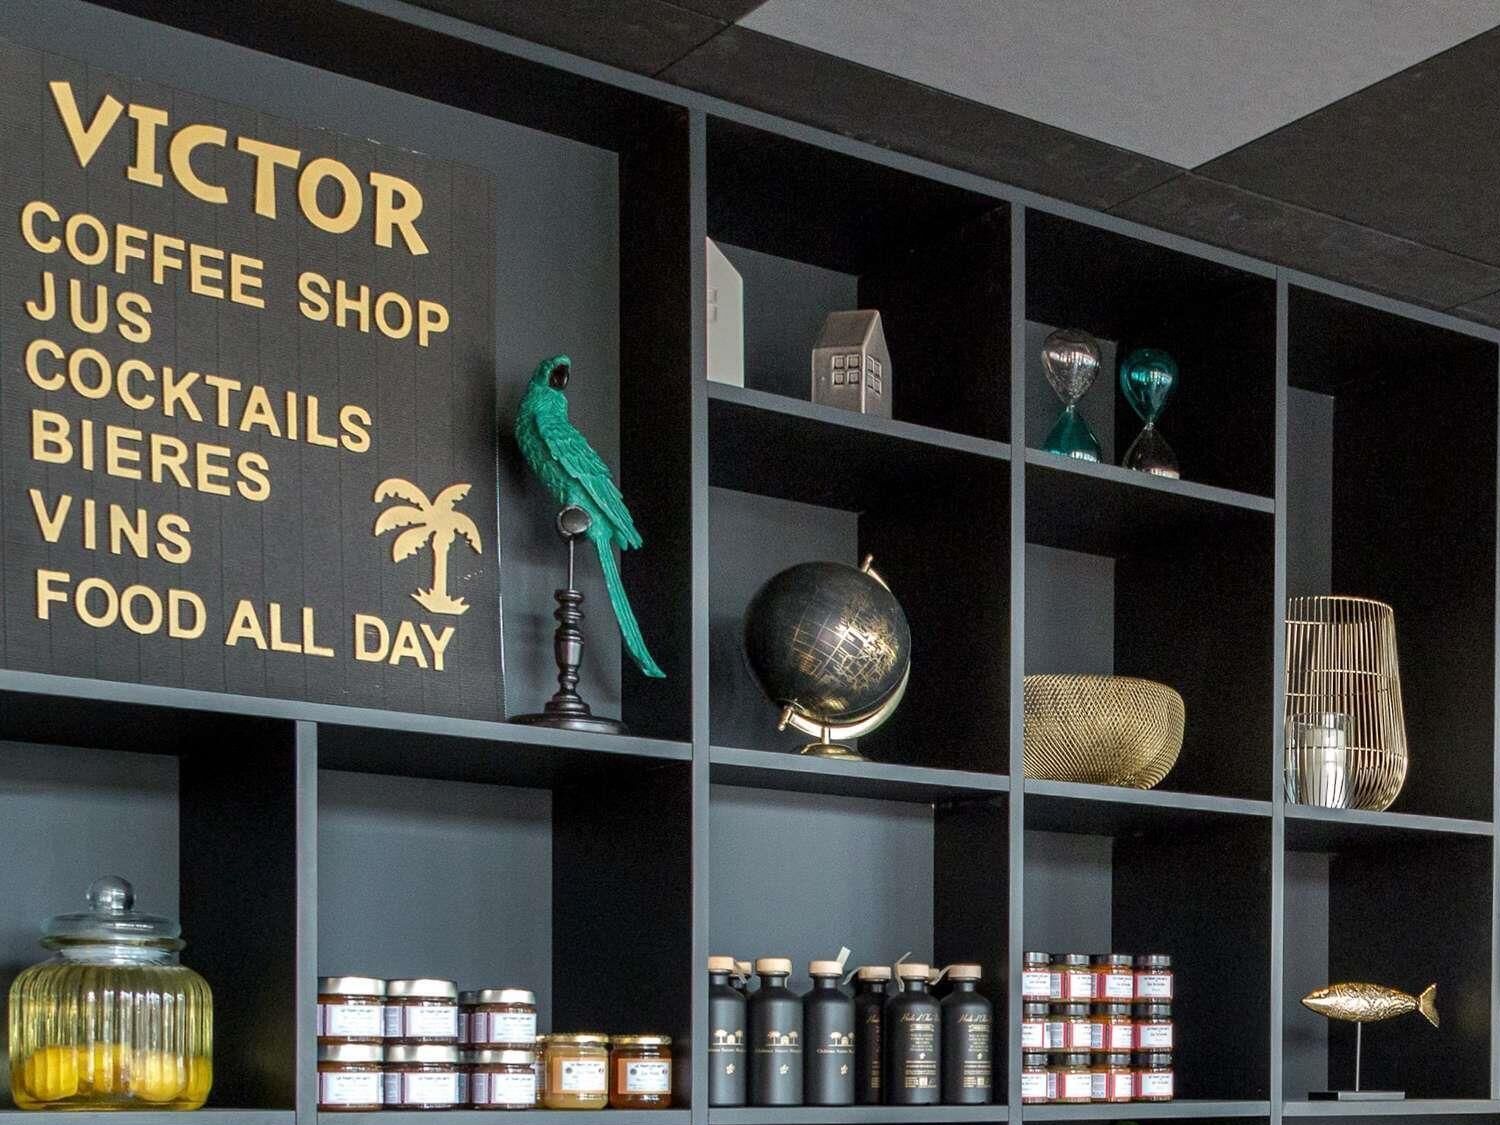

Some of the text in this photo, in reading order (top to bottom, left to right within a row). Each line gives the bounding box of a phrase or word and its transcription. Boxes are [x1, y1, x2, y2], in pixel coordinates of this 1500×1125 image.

[50, 81, 429, 255] VICTOR
[21, 201, 450, 347] COFFEE SHOP
[26, 272, 153, 343] JUS
[25, 339, 372, 453] COCKTAILS
[32, 409, 271, 501] BIERES
[29, 489, 192, 564] VINS
[36, 569, 455, 671] FOOD ALL DAY
